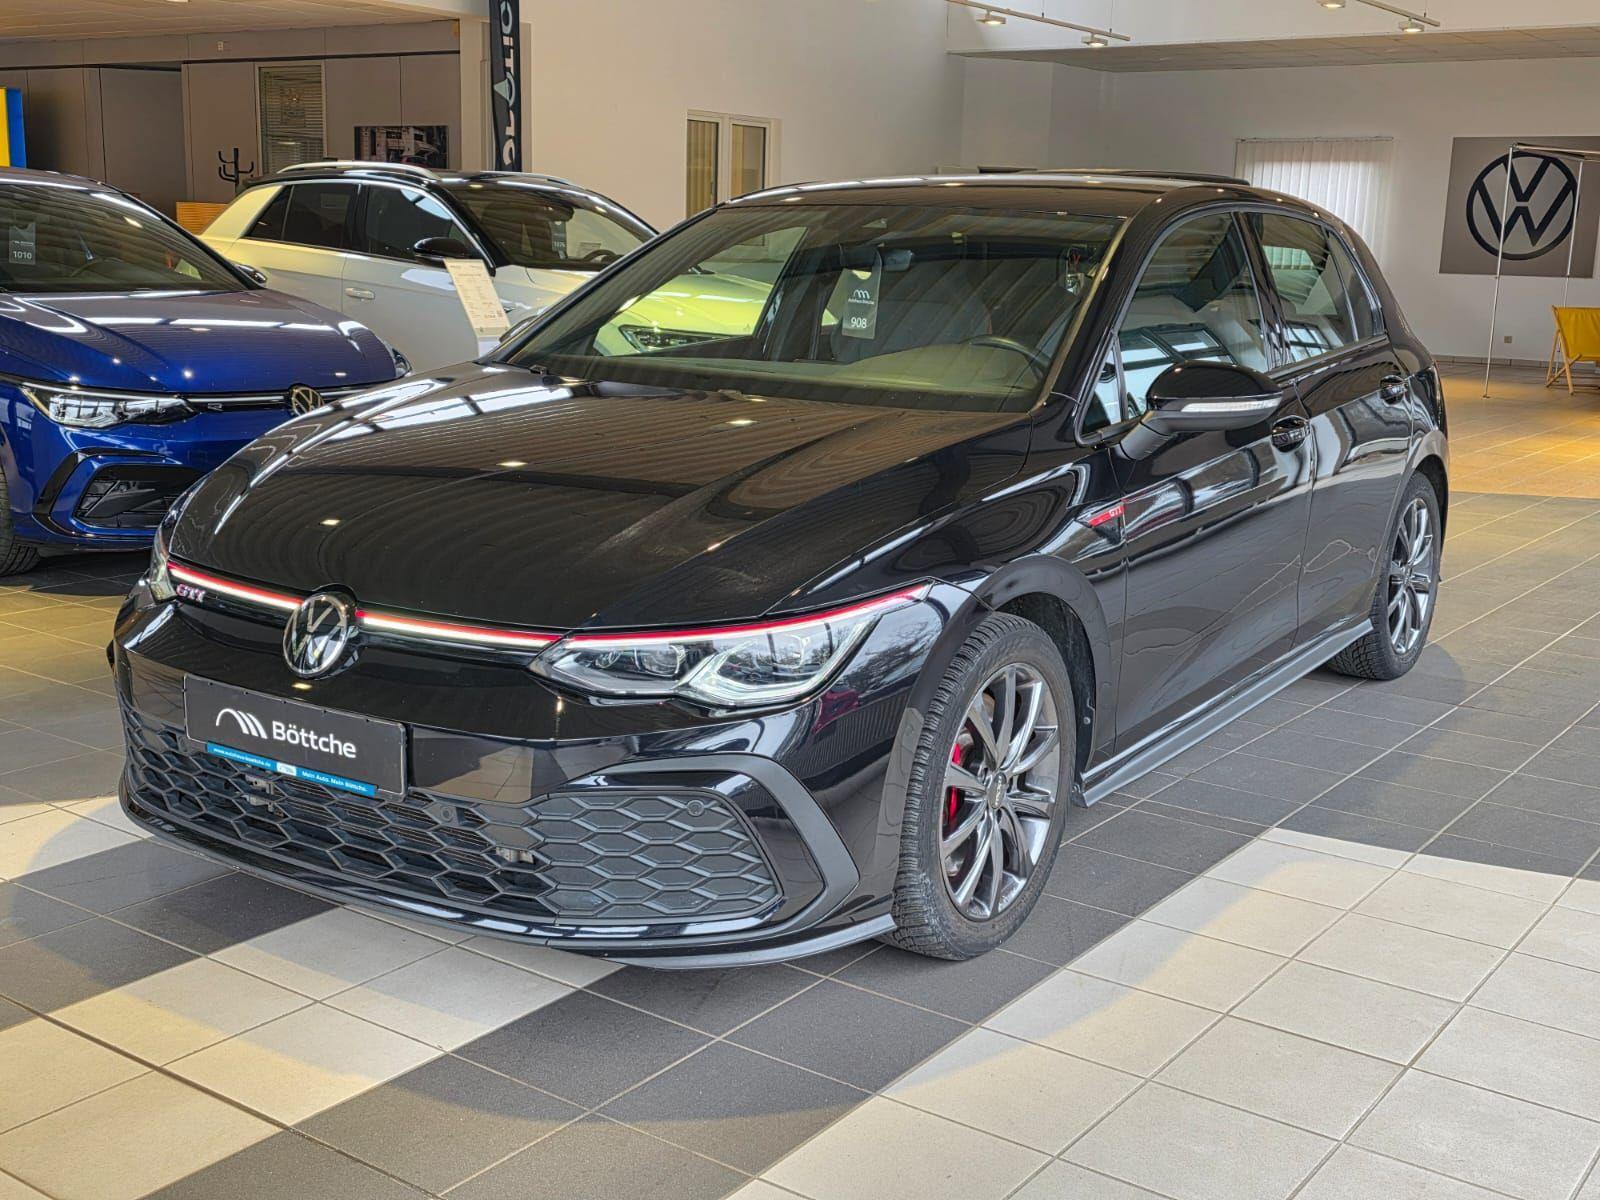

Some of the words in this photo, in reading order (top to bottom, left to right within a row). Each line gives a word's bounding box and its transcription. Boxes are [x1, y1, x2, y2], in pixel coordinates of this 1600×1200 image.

[851, 317, 867, 328] 908
[176, 583, 205, 602] GTI
[272, 720, 357, 758] Böttche
